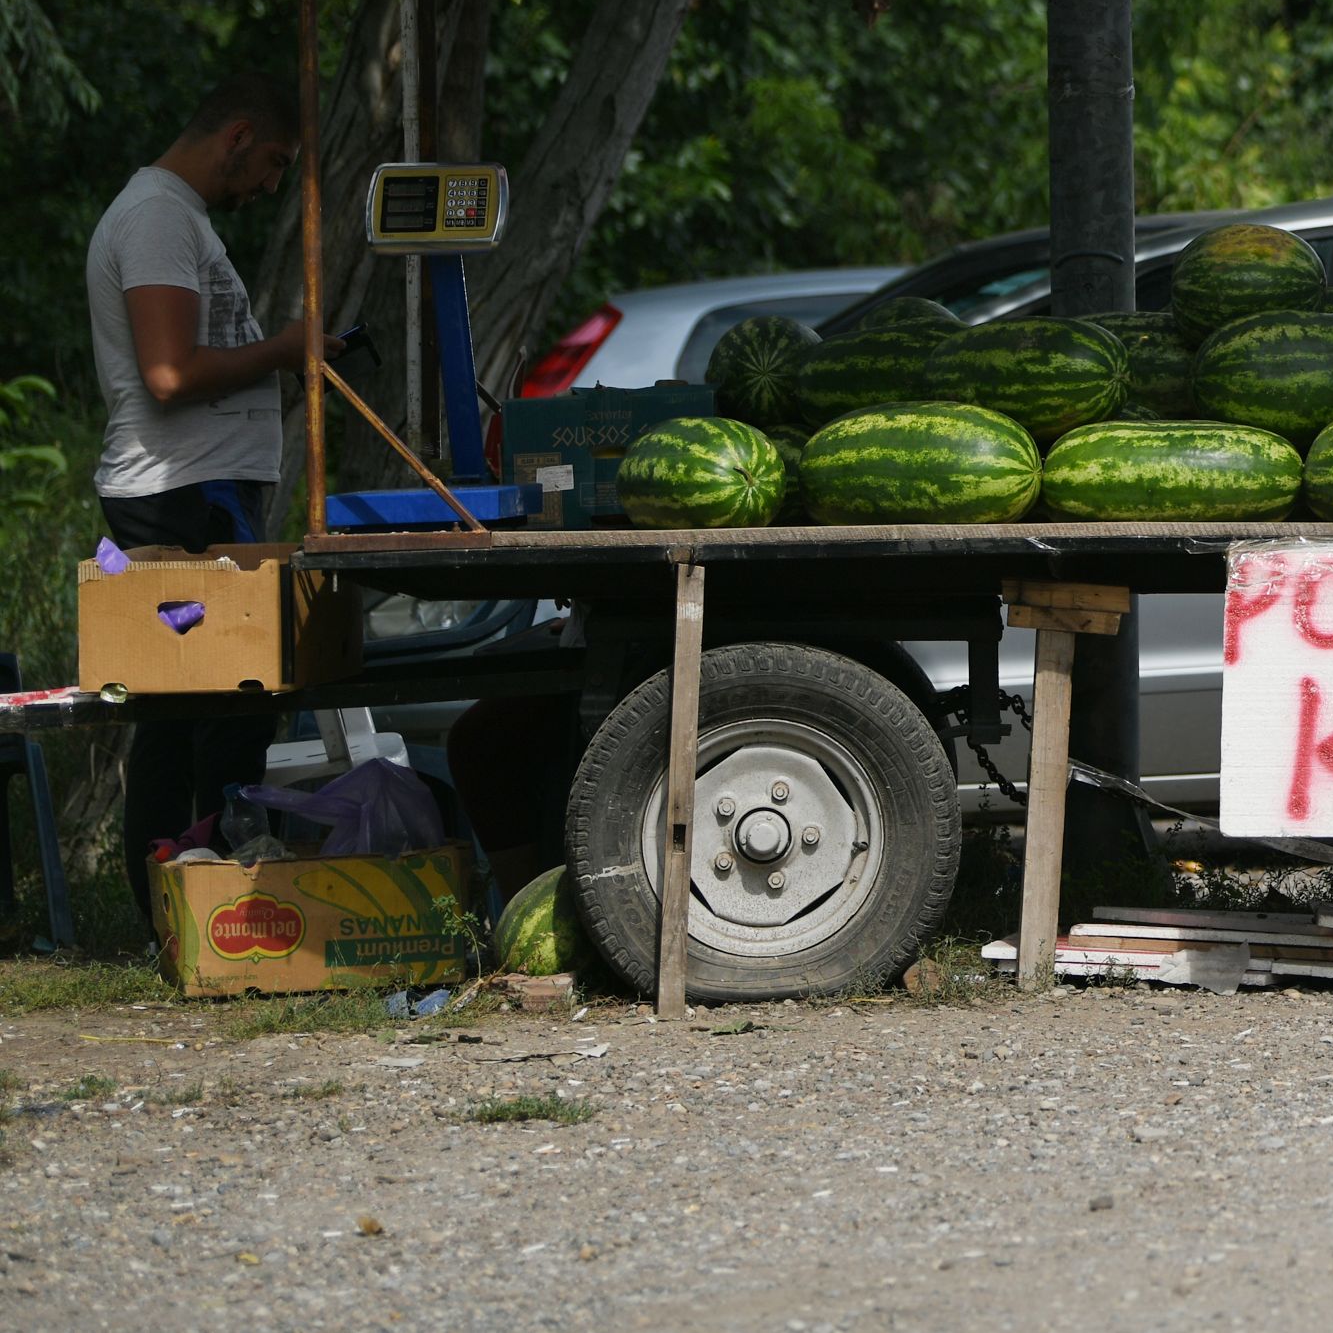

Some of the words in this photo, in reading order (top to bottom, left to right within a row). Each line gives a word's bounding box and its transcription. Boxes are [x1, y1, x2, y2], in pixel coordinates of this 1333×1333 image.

[214, 921, 268, 940] Monte
[271, 920, 297, 938] Del
[355, 937, 456, 958] Premium
